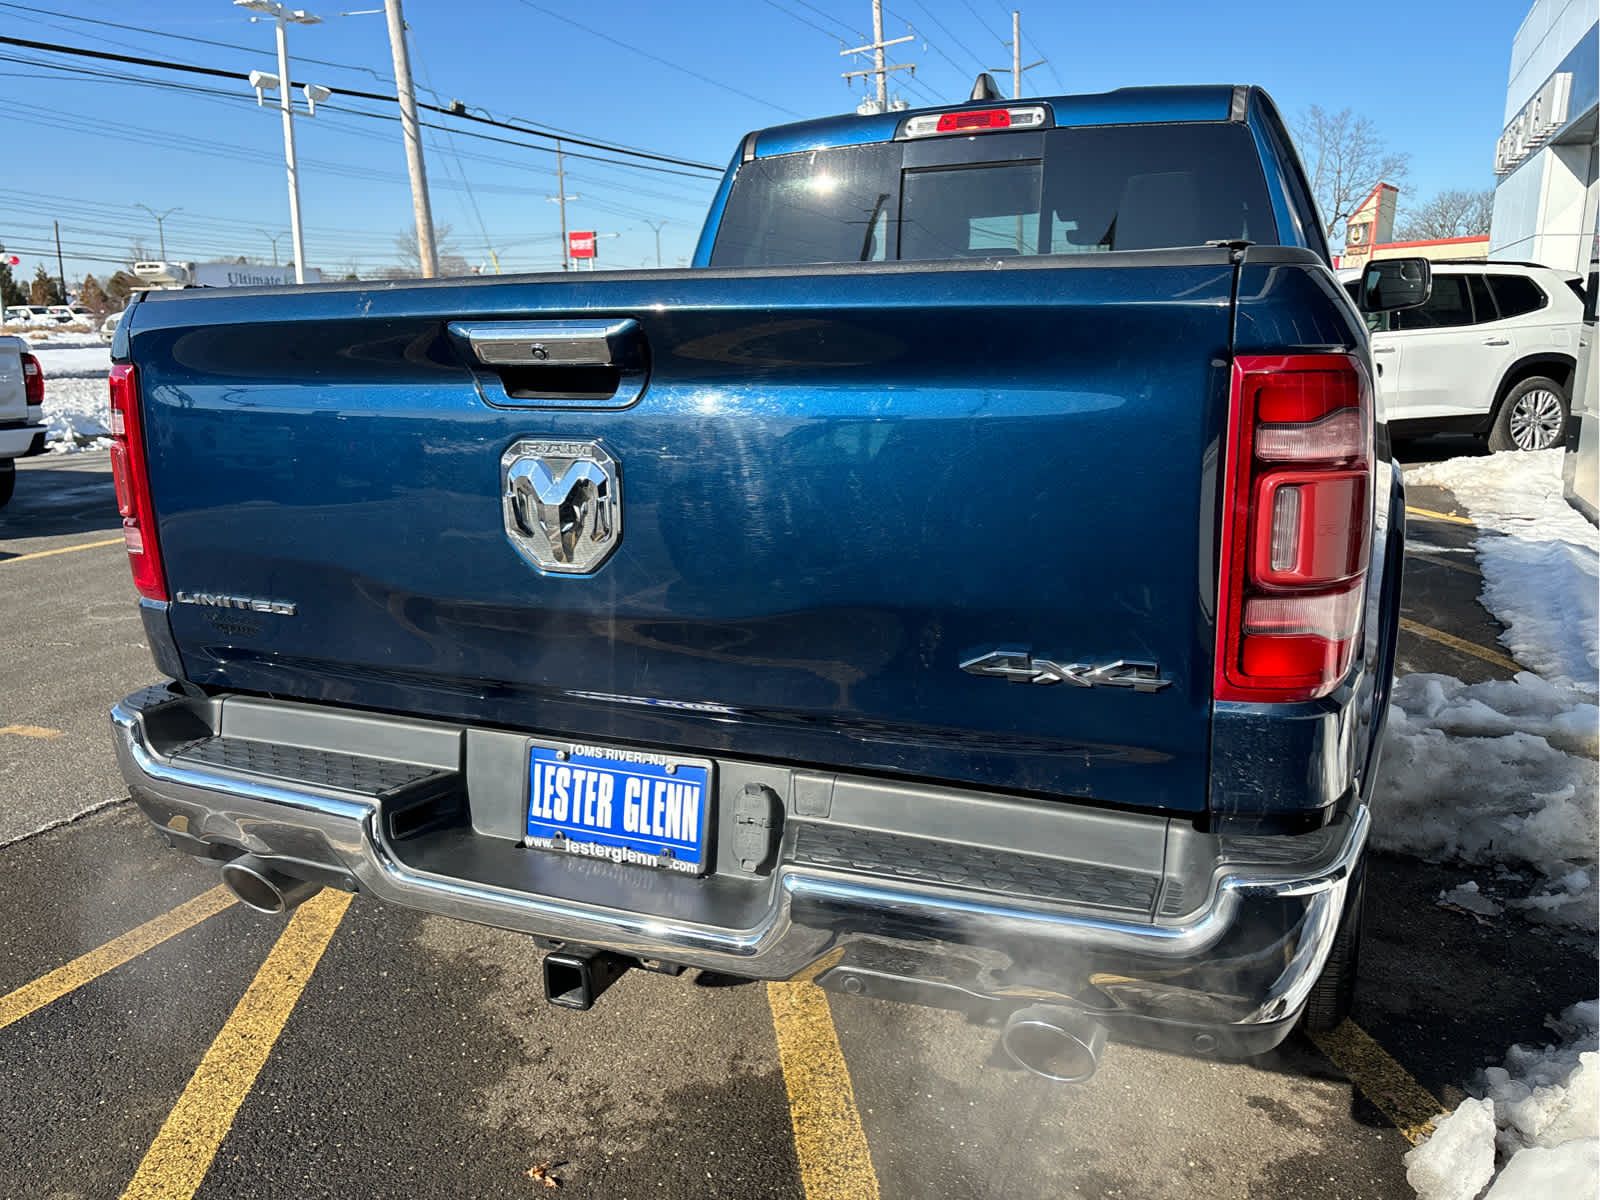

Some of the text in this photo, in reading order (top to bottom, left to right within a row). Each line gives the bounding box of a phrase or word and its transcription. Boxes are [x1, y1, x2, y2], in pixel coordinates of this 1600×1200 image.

[520, 443, 593, 457] RAM
[176, 591, 296, 616] LIMITED
[568, 743, 603, 759] TOMS
[648, 754, 667, 766] NJ
[531, 763, 700, 843] LESTER GLENN
